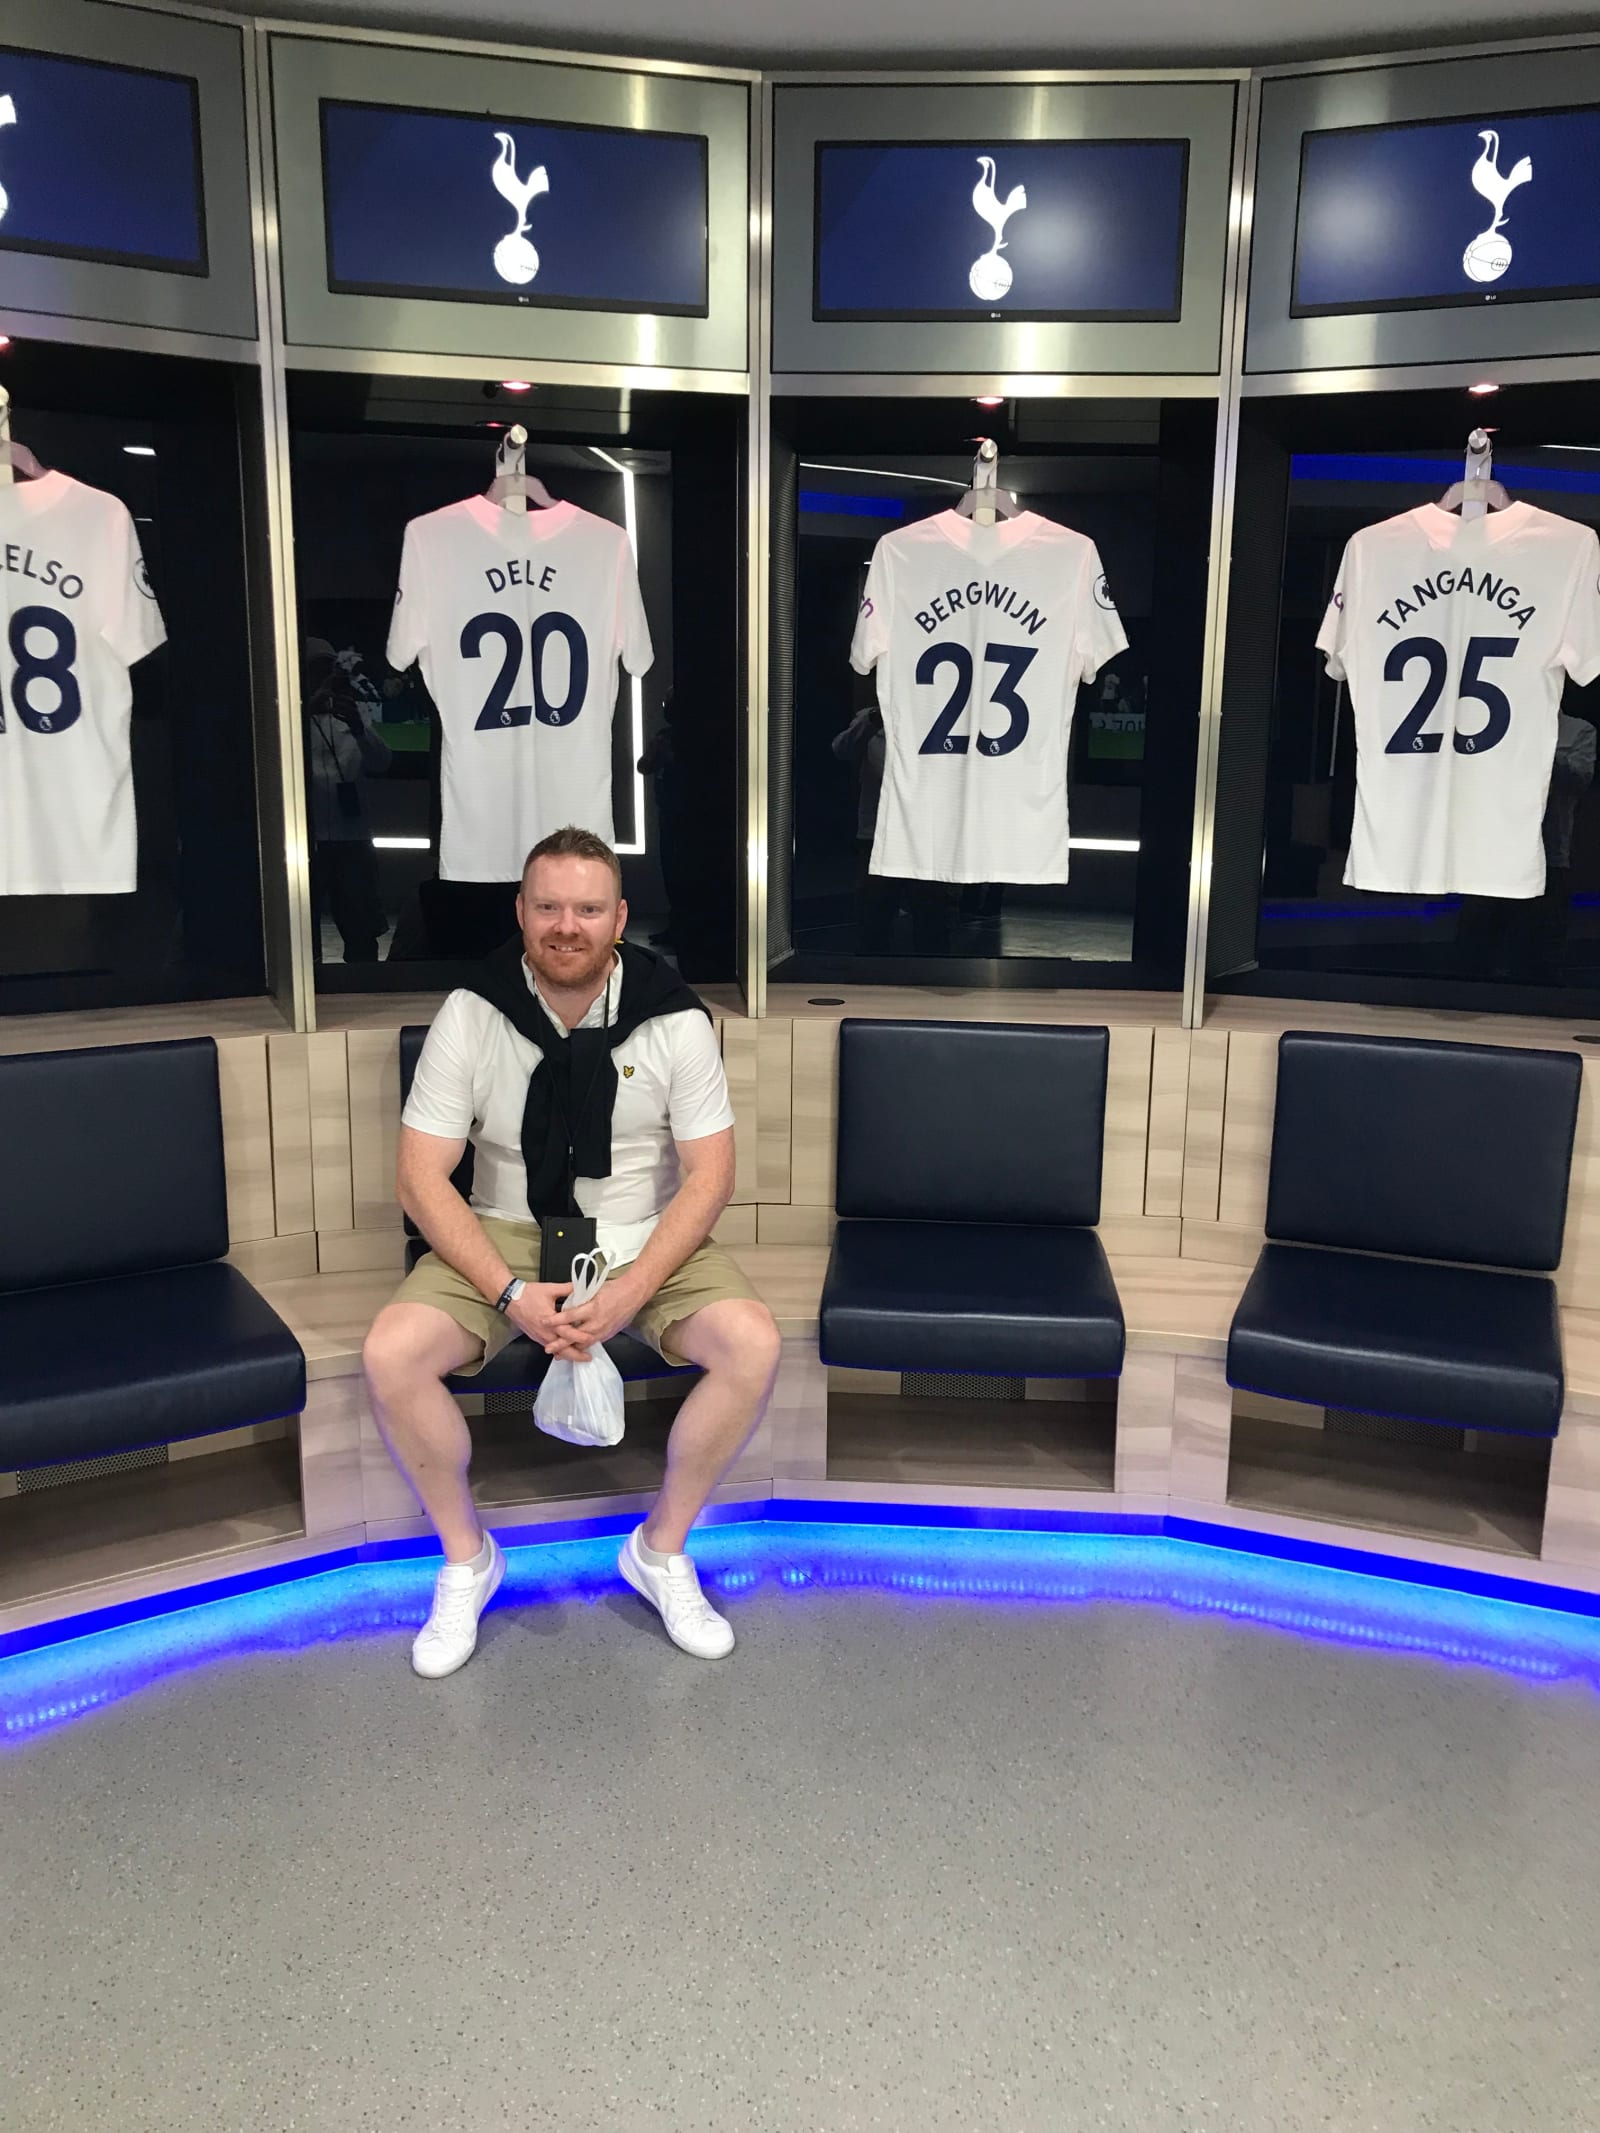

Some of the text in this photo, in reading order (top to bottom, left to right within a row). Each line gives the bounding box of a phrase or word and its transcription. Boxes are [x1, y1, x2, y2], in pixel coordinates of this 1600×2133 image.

[0, 543, 83, 599] ELSO
[485, 559, 557, 594] DELE
[1376, 567, 1537, 631] TANGANGA
[914, 580, 1047, 636] BERGWIJN
[459, 611, 589, 732] 20
[915, 641, 1039, 757] 23
[1383, 636, 1521, 755] 25
